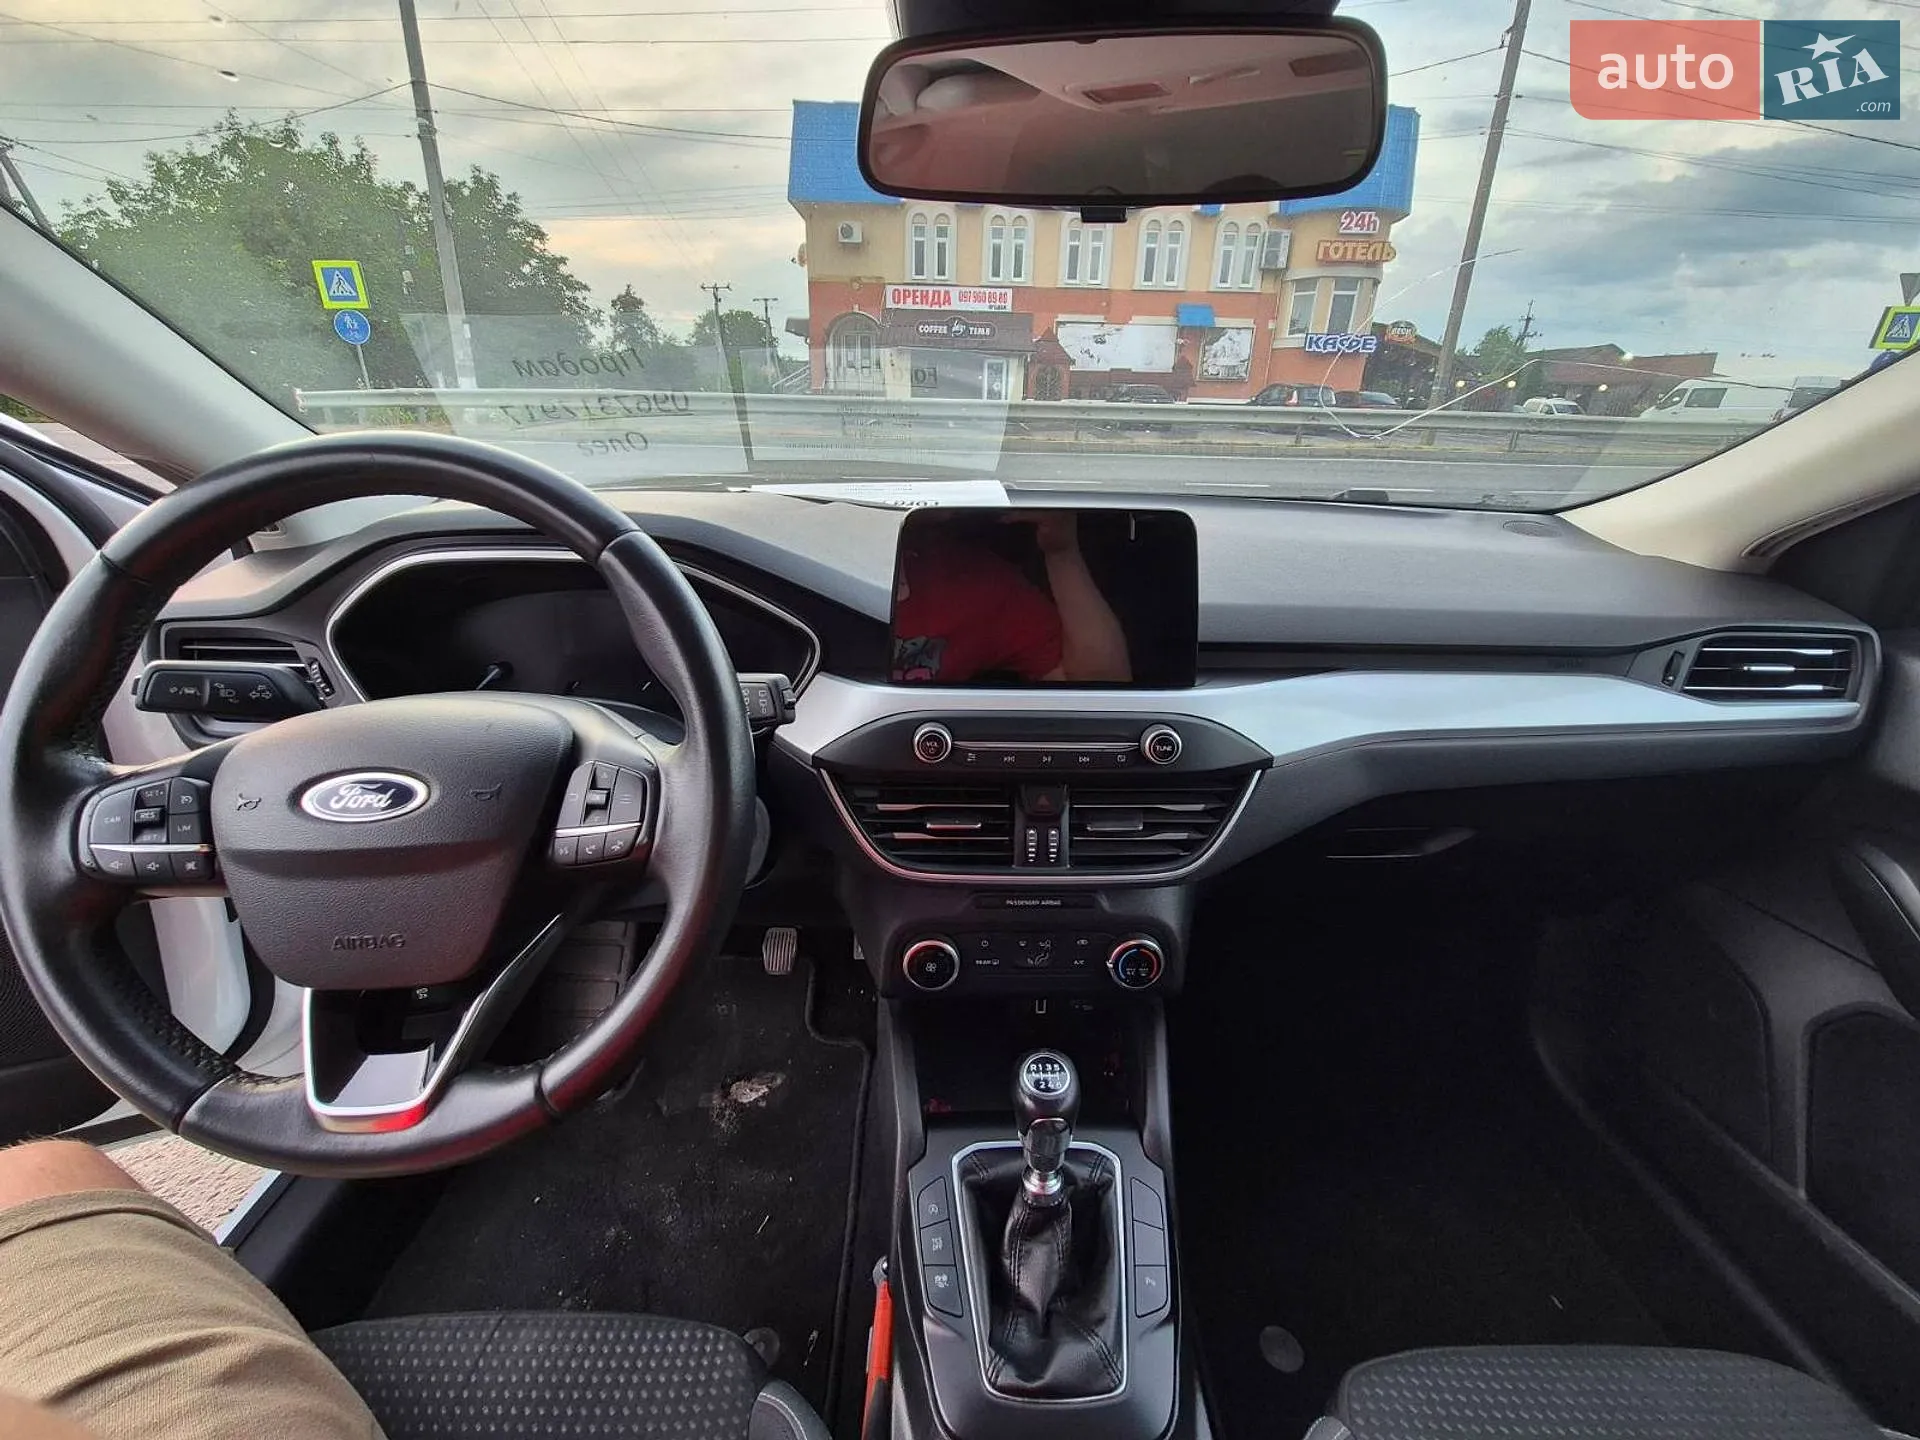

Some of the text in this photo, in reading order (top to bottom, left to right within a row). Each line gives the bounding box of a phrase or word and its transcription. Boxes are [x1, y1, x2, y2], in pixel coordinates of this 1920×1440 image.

[1341, 212, 1379, 232] 24h
[1317, 240, 1396, 261] ГОТЕЛЬ
[892, 288, 952, 308] ОРЕНДА
[1306, 335, 1377, 353] КАФЕ
[330, 783, 397, 810] Ford
[333, 933, 406, 950] AIRBAG
